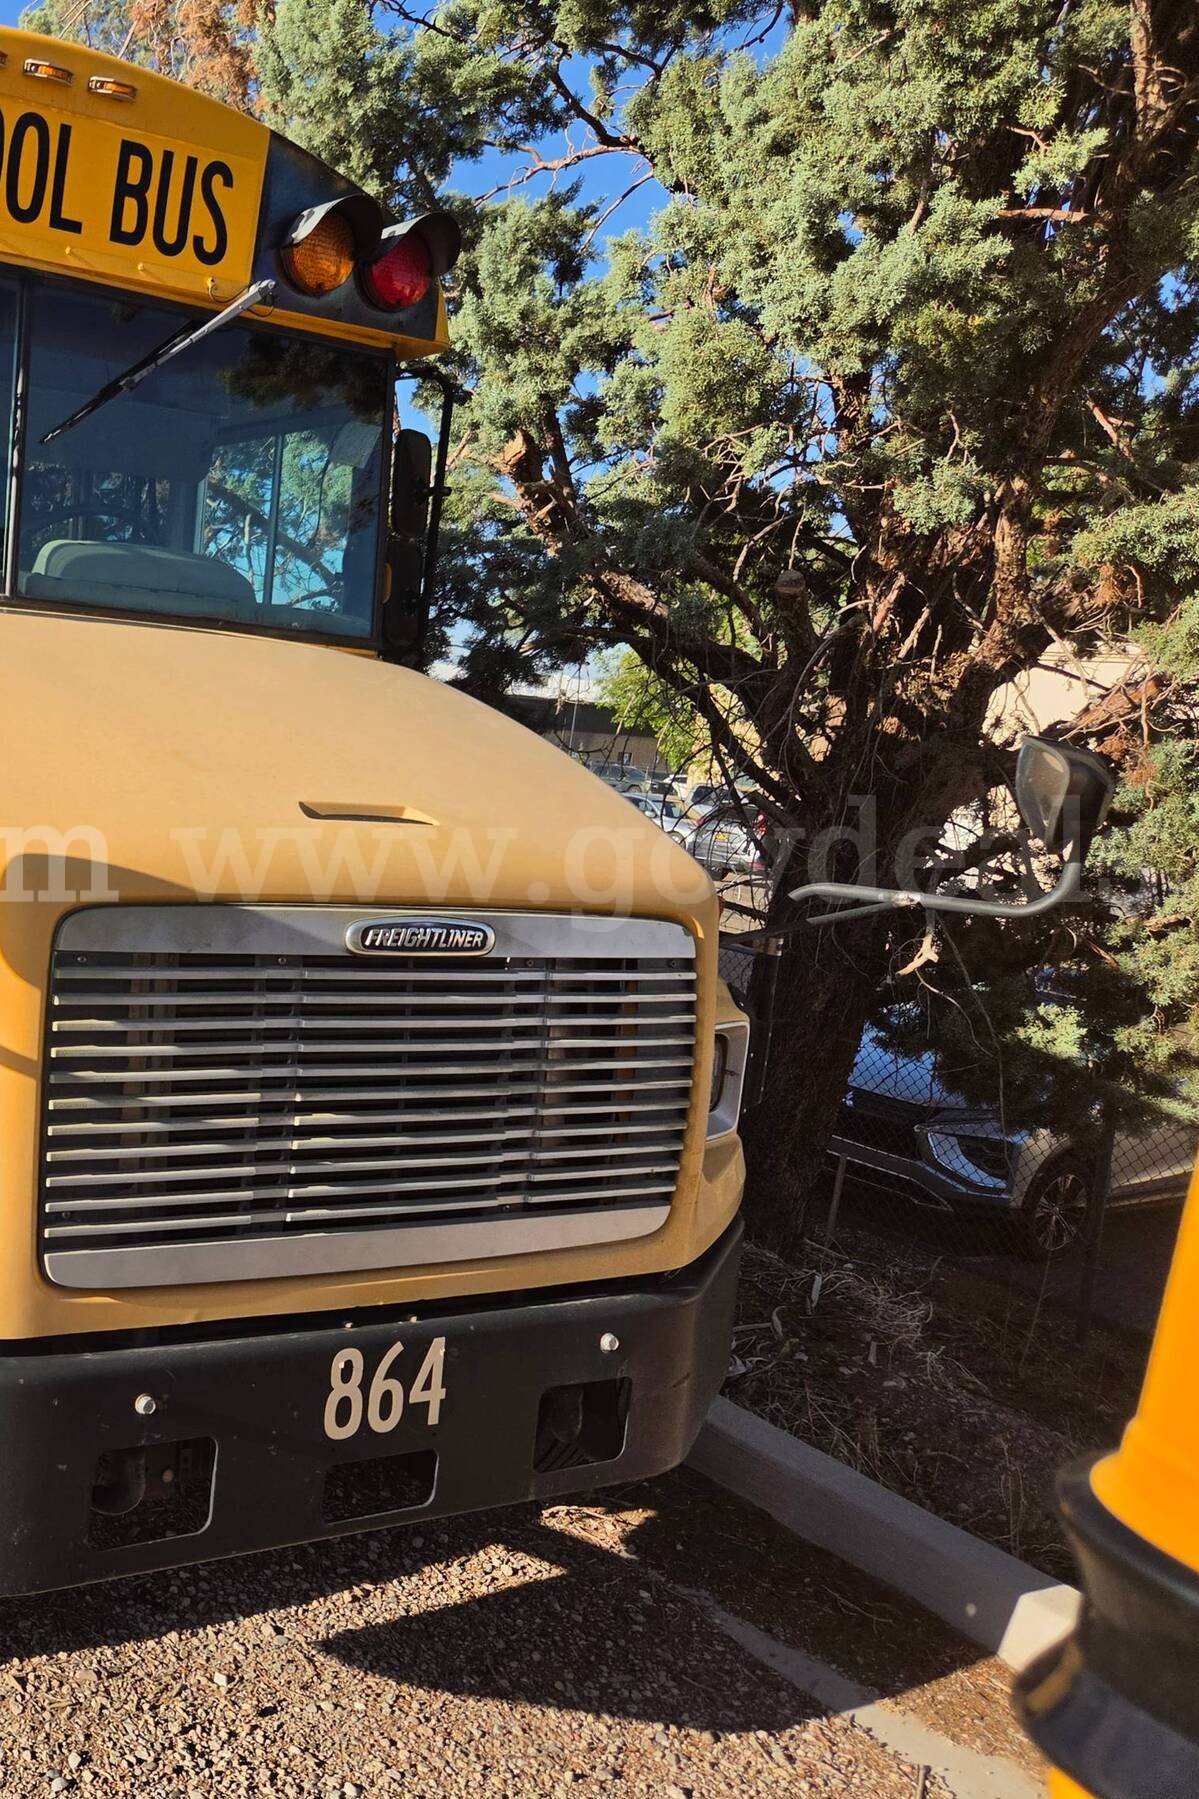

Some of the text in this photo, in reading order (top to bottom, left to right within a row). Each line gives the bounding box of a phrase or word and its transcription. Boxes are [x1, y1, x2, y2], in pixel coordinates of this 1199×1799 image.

[109, 138, 234, 266] BUS
[364, 927, 483, 948] FREIGHTLINER
[323, 1336, 447, 1440] 864
